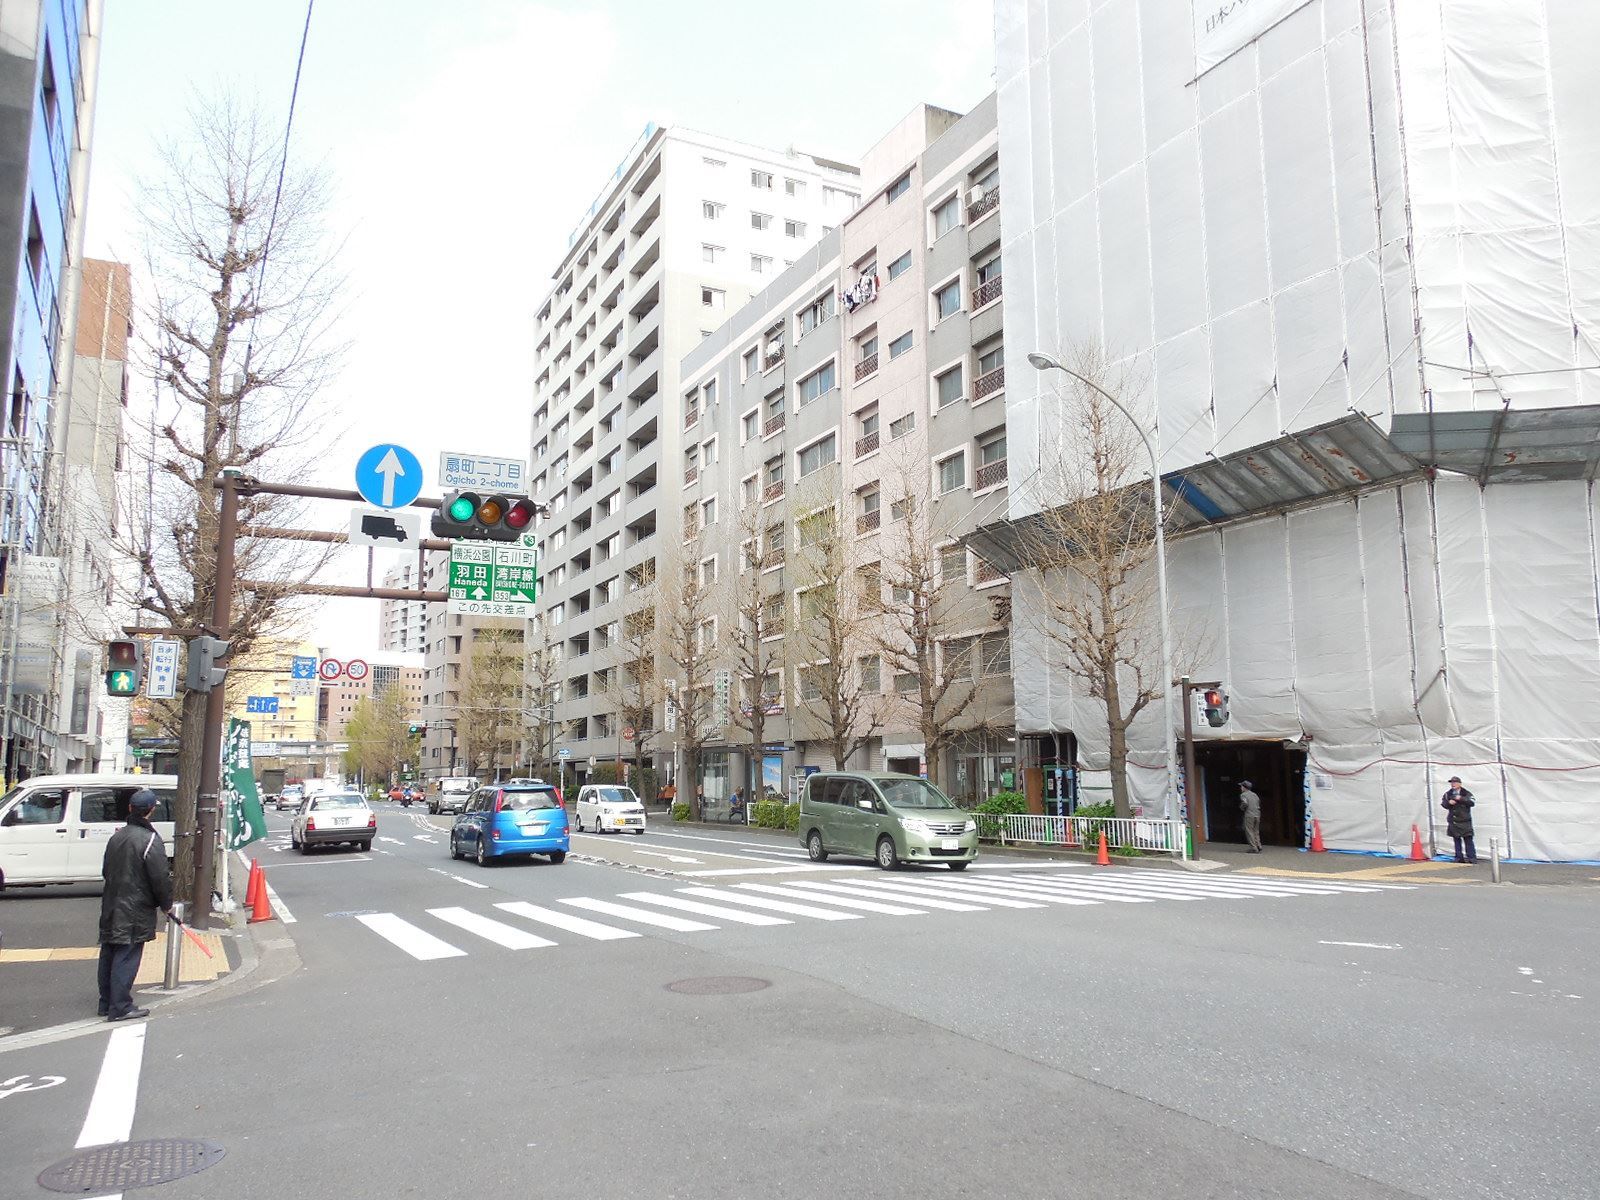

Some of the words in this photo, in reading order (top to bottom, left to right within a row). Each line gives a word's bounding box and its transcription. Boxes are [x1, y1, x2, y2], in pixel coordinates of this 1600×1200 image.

[445, 457, 520, 479] 扇町二丁目
[446, 474, 476, 485] Ogicho
[480, 478, 519, 489] 2-chome
[454, 547, 491, 562] 横浜公園
[498, 551, 533, 565] 石川町
[457, 564, 487, 579] 羽田
[496, 567, 534, 581] 湾岸線
[454, 577, 488, 587] Haneda
[458, 602, 526, 615] この先交差点
[350, 664, 364, 675] 50
